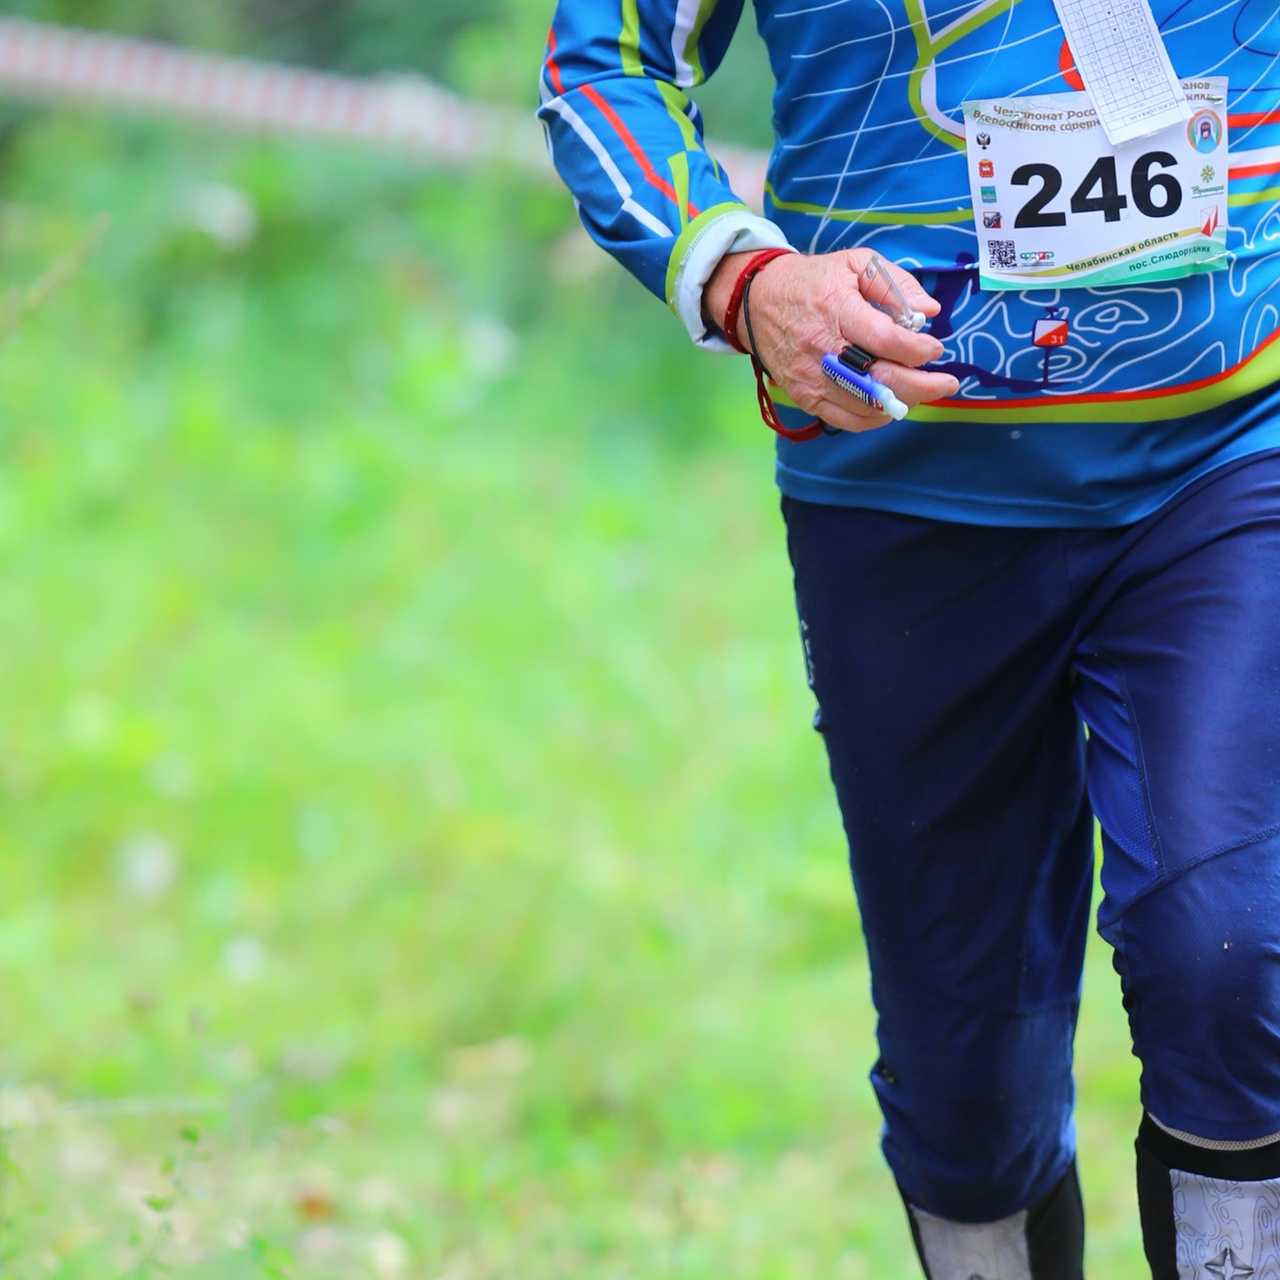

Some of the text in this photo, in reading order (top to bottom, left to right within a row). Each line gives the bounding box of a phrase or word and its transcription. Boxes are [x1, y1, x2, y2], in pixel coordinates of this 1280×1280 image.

[1010, 151, 1183, 229] 246
[1066, 231, 1179, 272] Челябинская область
[1050, 334, 1064, 344] 31
